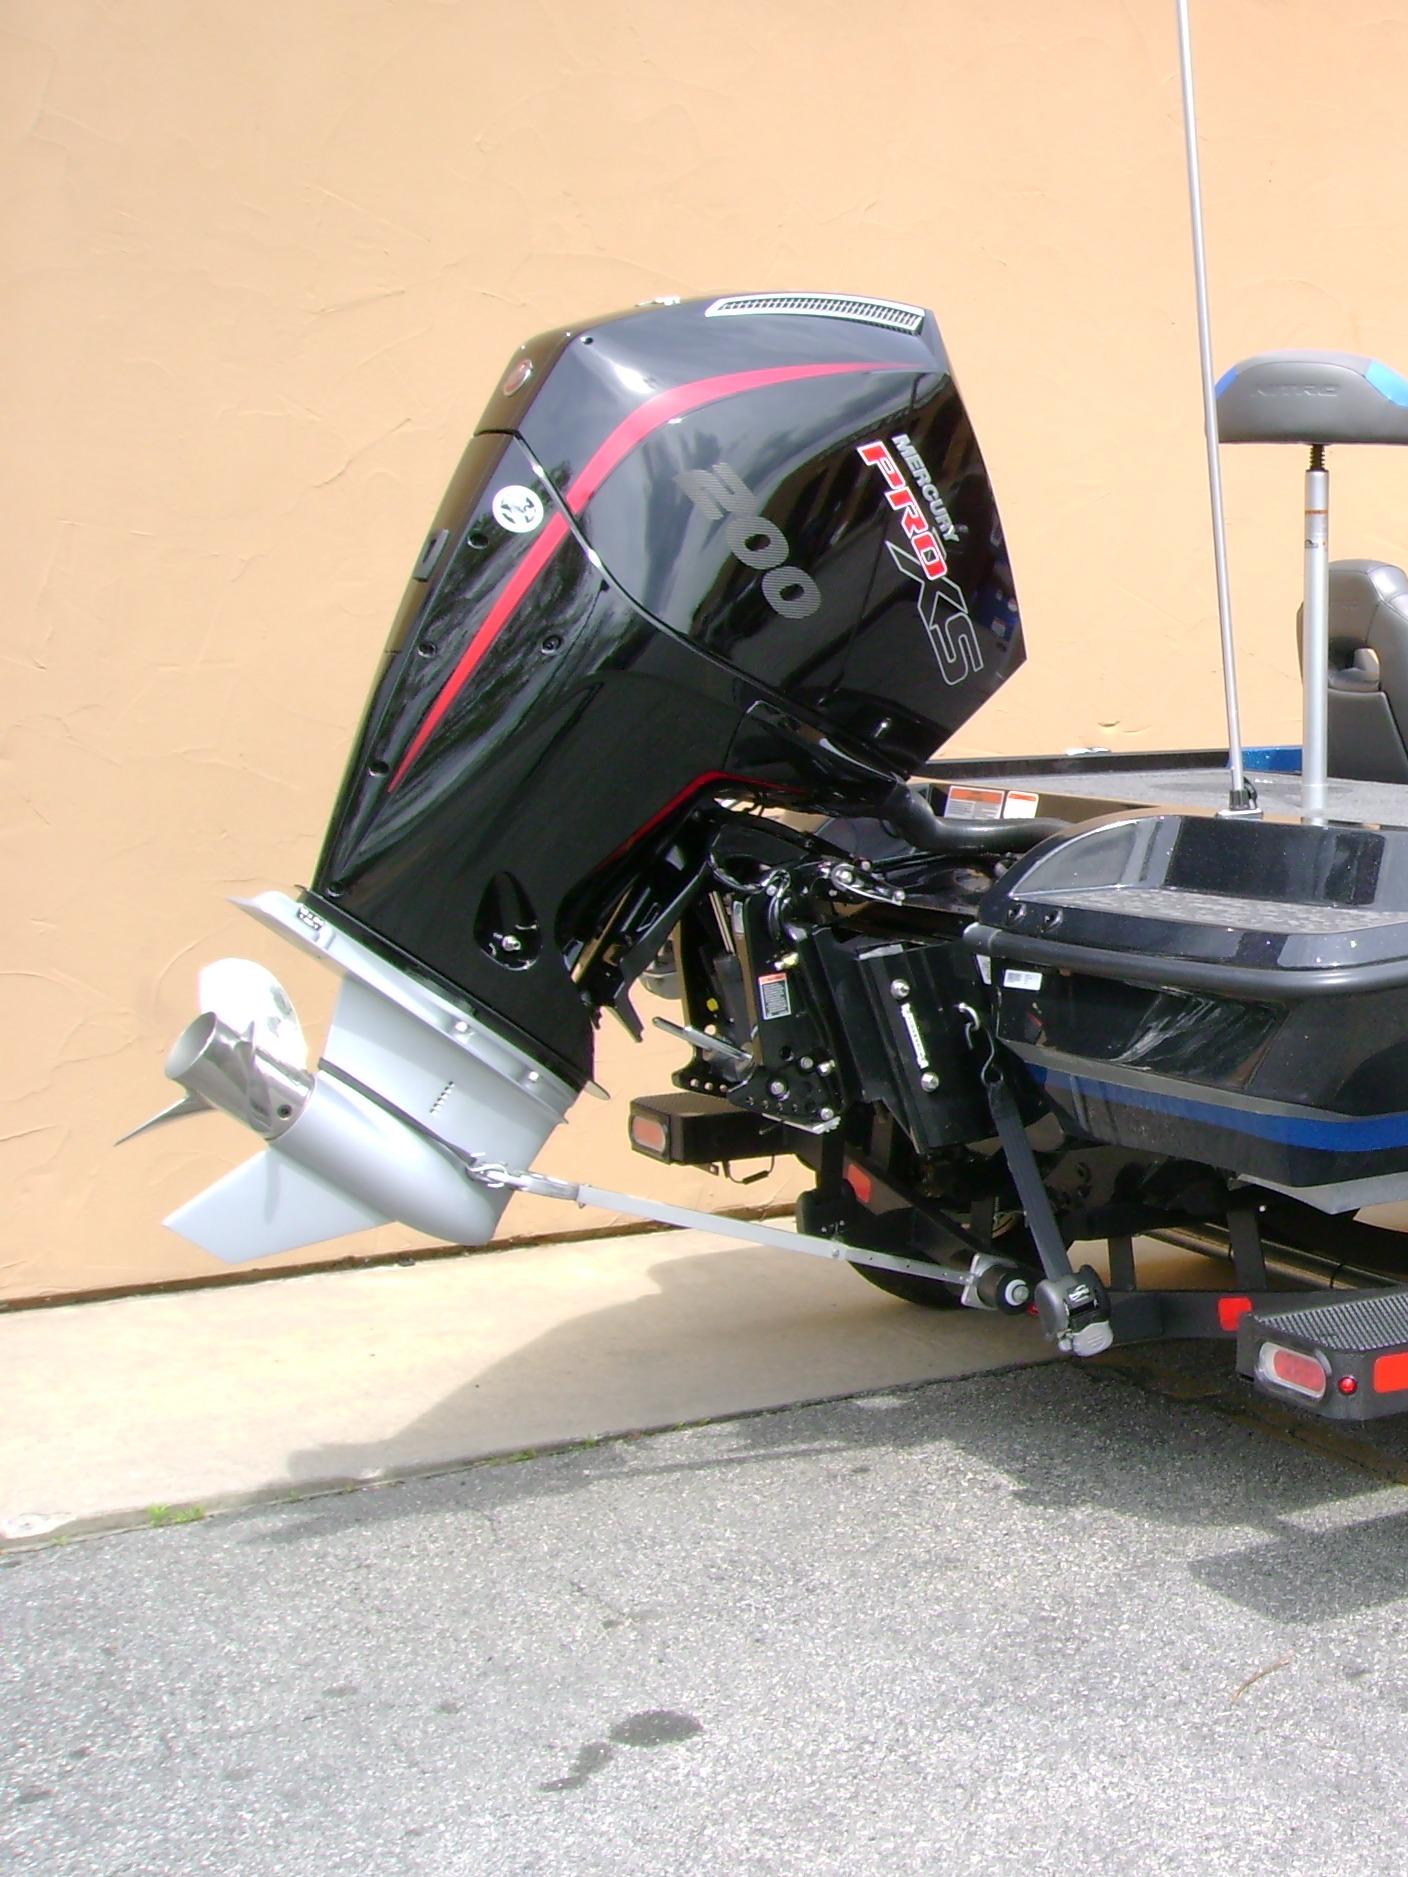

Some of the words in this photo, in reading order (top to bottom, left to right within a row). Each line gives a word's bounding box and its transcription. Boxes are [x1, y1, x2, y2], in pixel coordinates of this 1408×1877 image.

[673, 462, 822, 620] 200
[857, 440, 947, 580] PRO
[891, 433, 960, 543] MERCURY
[885, 540, 984, 686] XS
